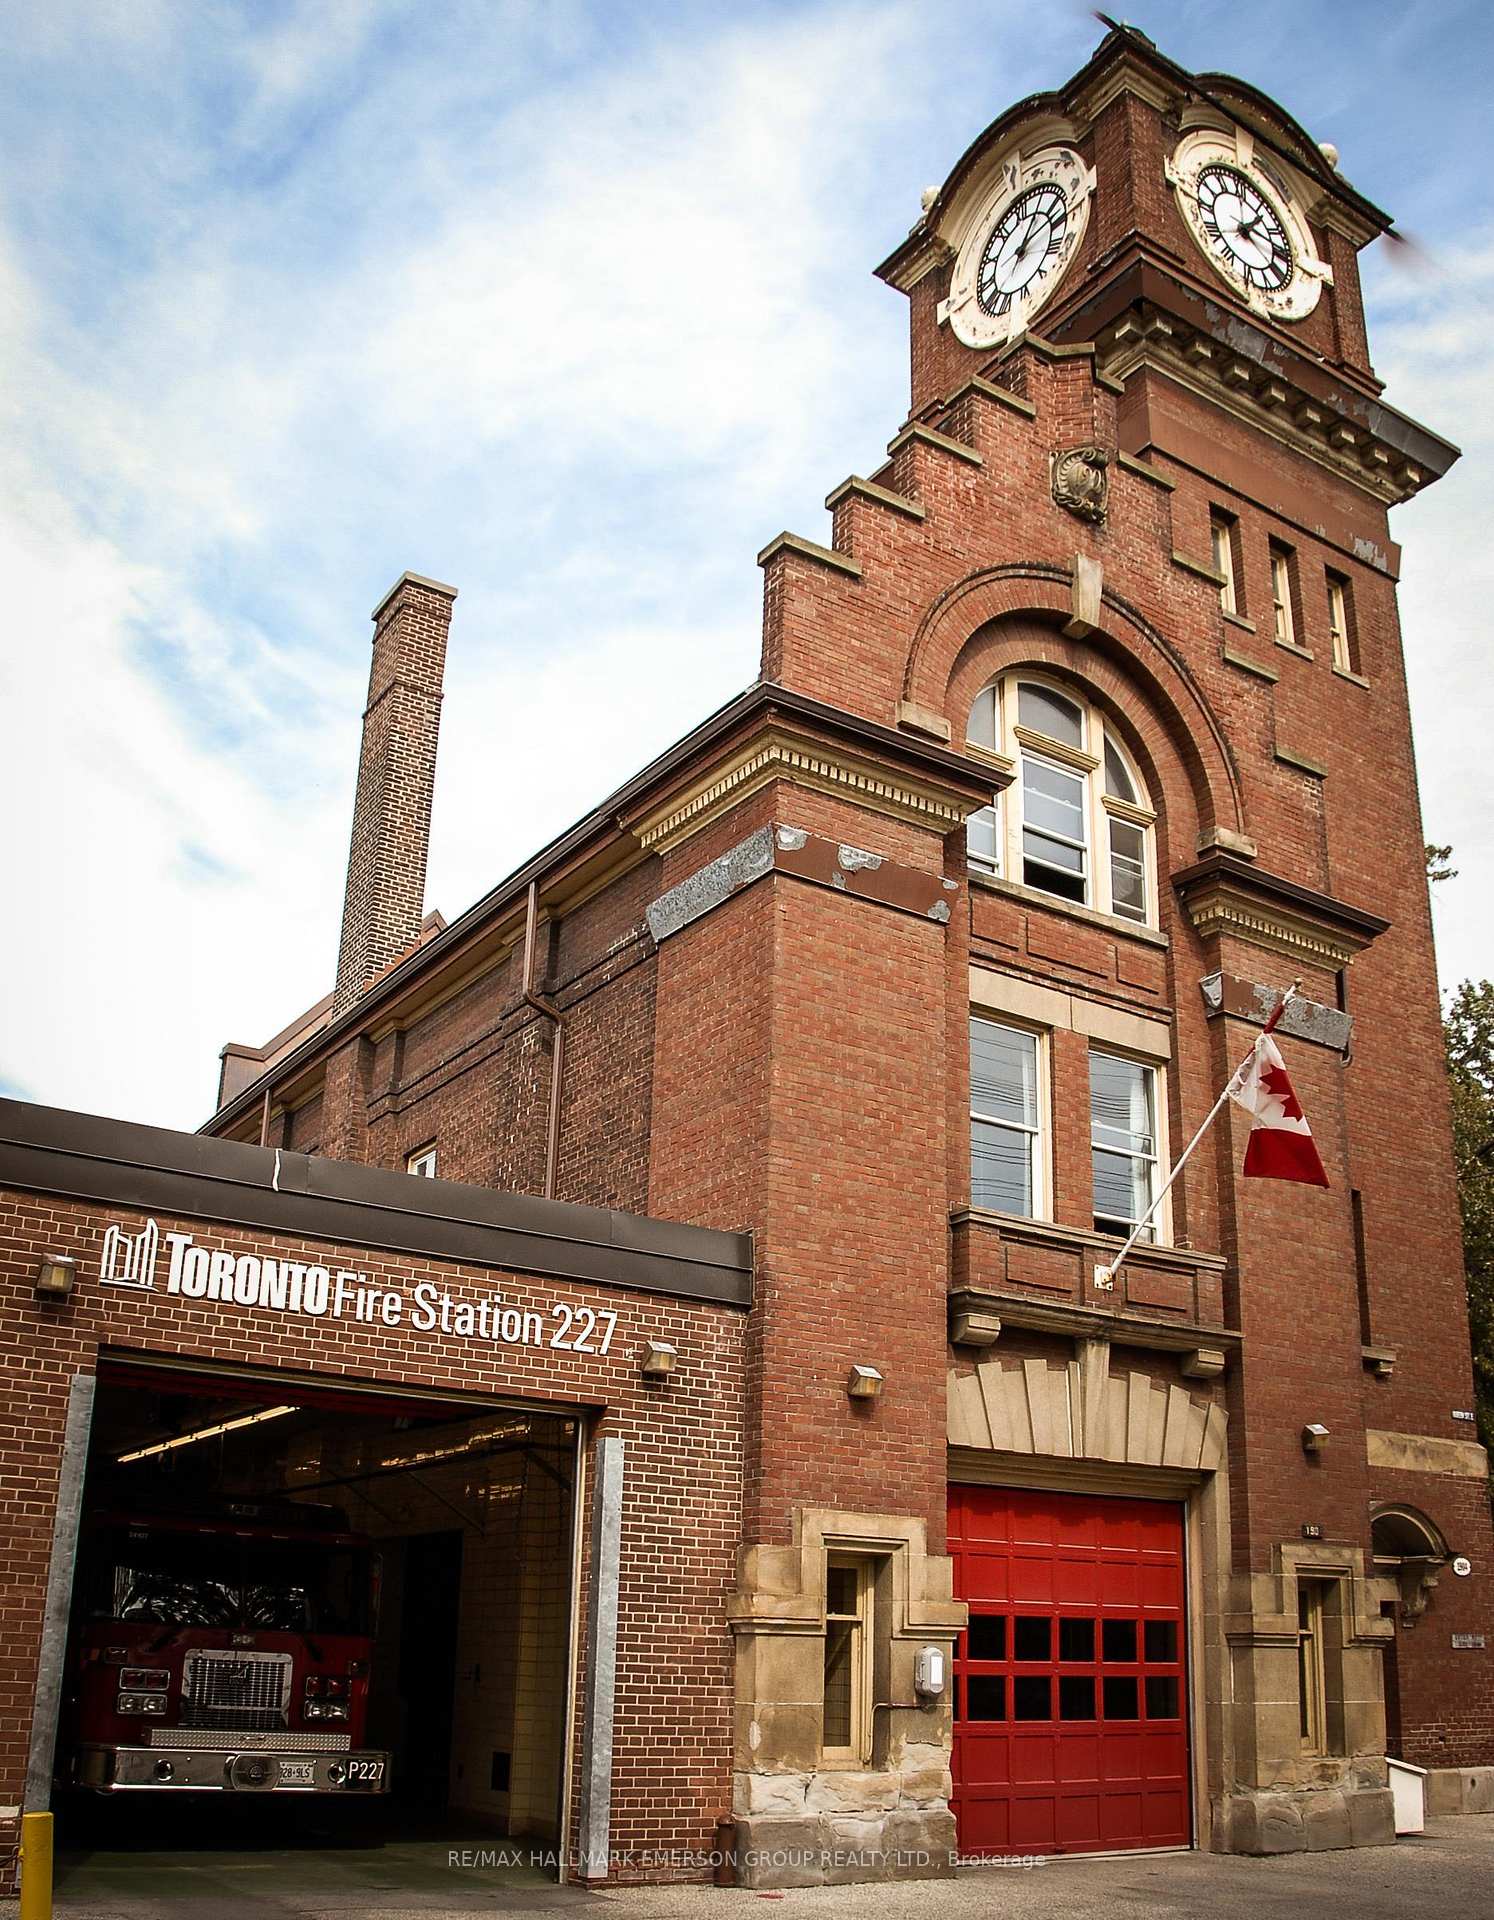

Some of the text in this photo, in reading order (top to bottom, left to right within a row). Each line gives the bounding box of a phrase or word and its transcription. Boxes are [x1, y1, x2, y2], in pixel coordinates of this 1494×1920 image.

[166, 1232, 617, 1355] TORONTO Fire Station 227
[349, 1761, 384, 1780] P227
